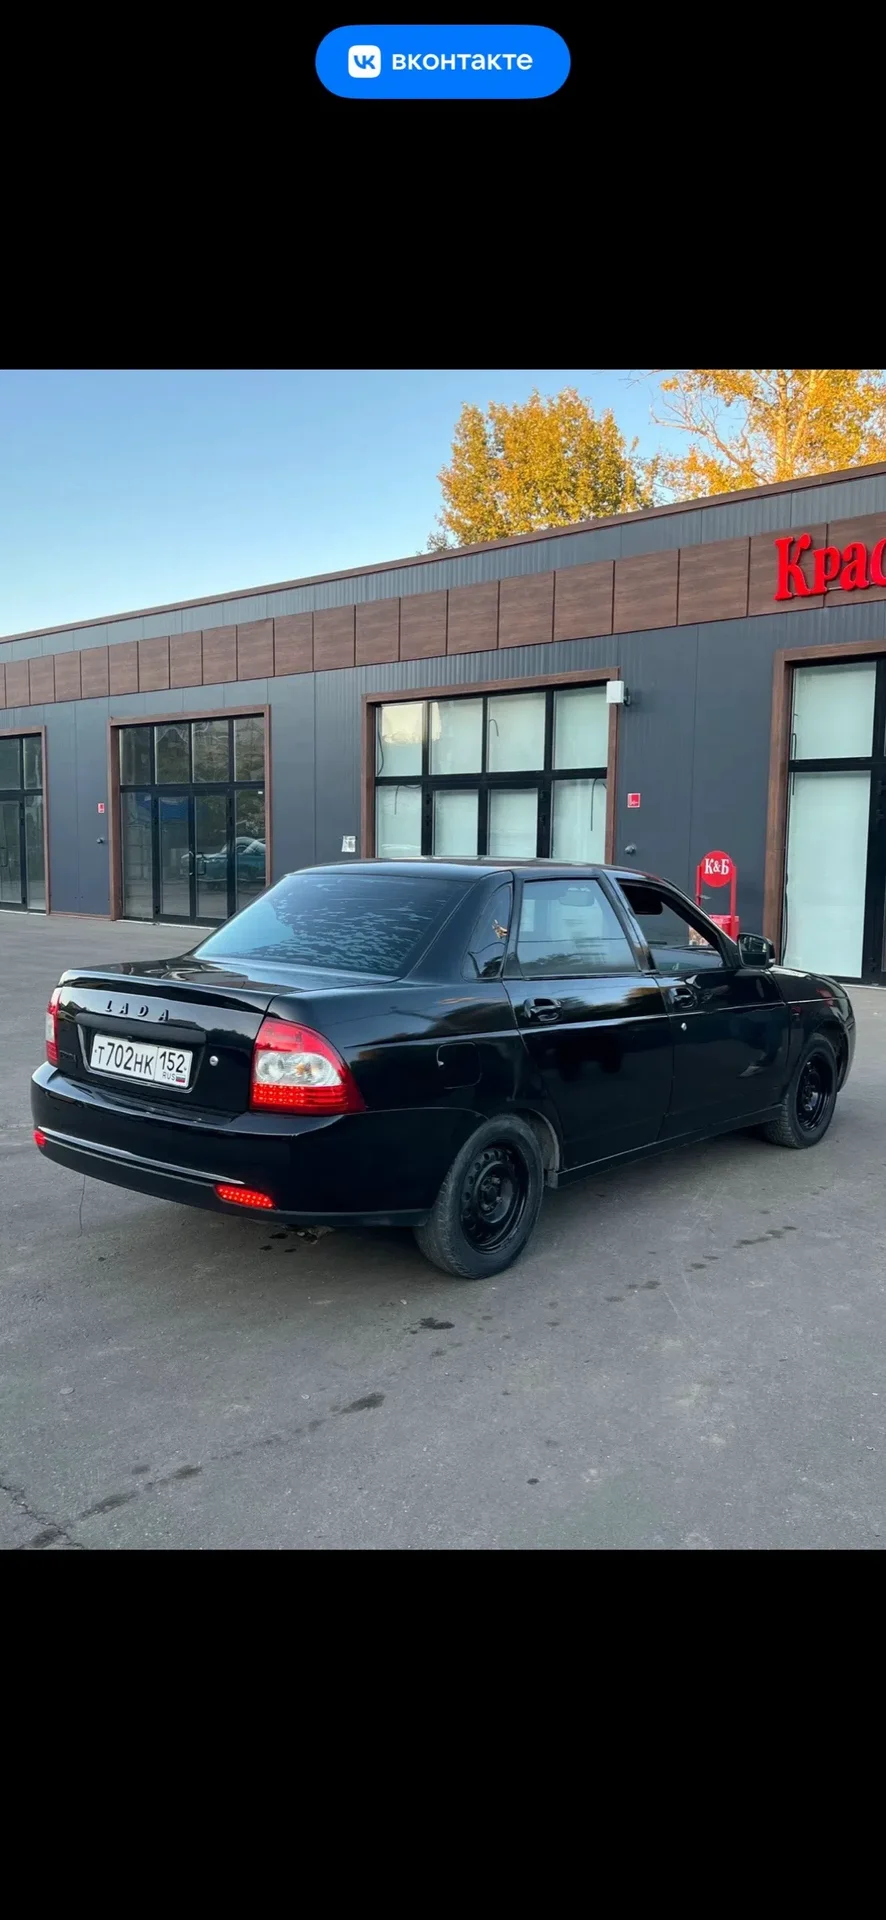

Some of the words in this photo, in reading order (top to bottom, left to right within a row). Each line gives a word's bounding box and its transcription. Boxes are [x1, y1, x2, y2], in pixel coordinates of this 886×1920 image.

[704, 858, 730, 875] К&Б
[105, 1000, 170, 1021] LADA
[159, 1050, 185, 1073] 152
[162, 1071, 176, 1081] RUS
